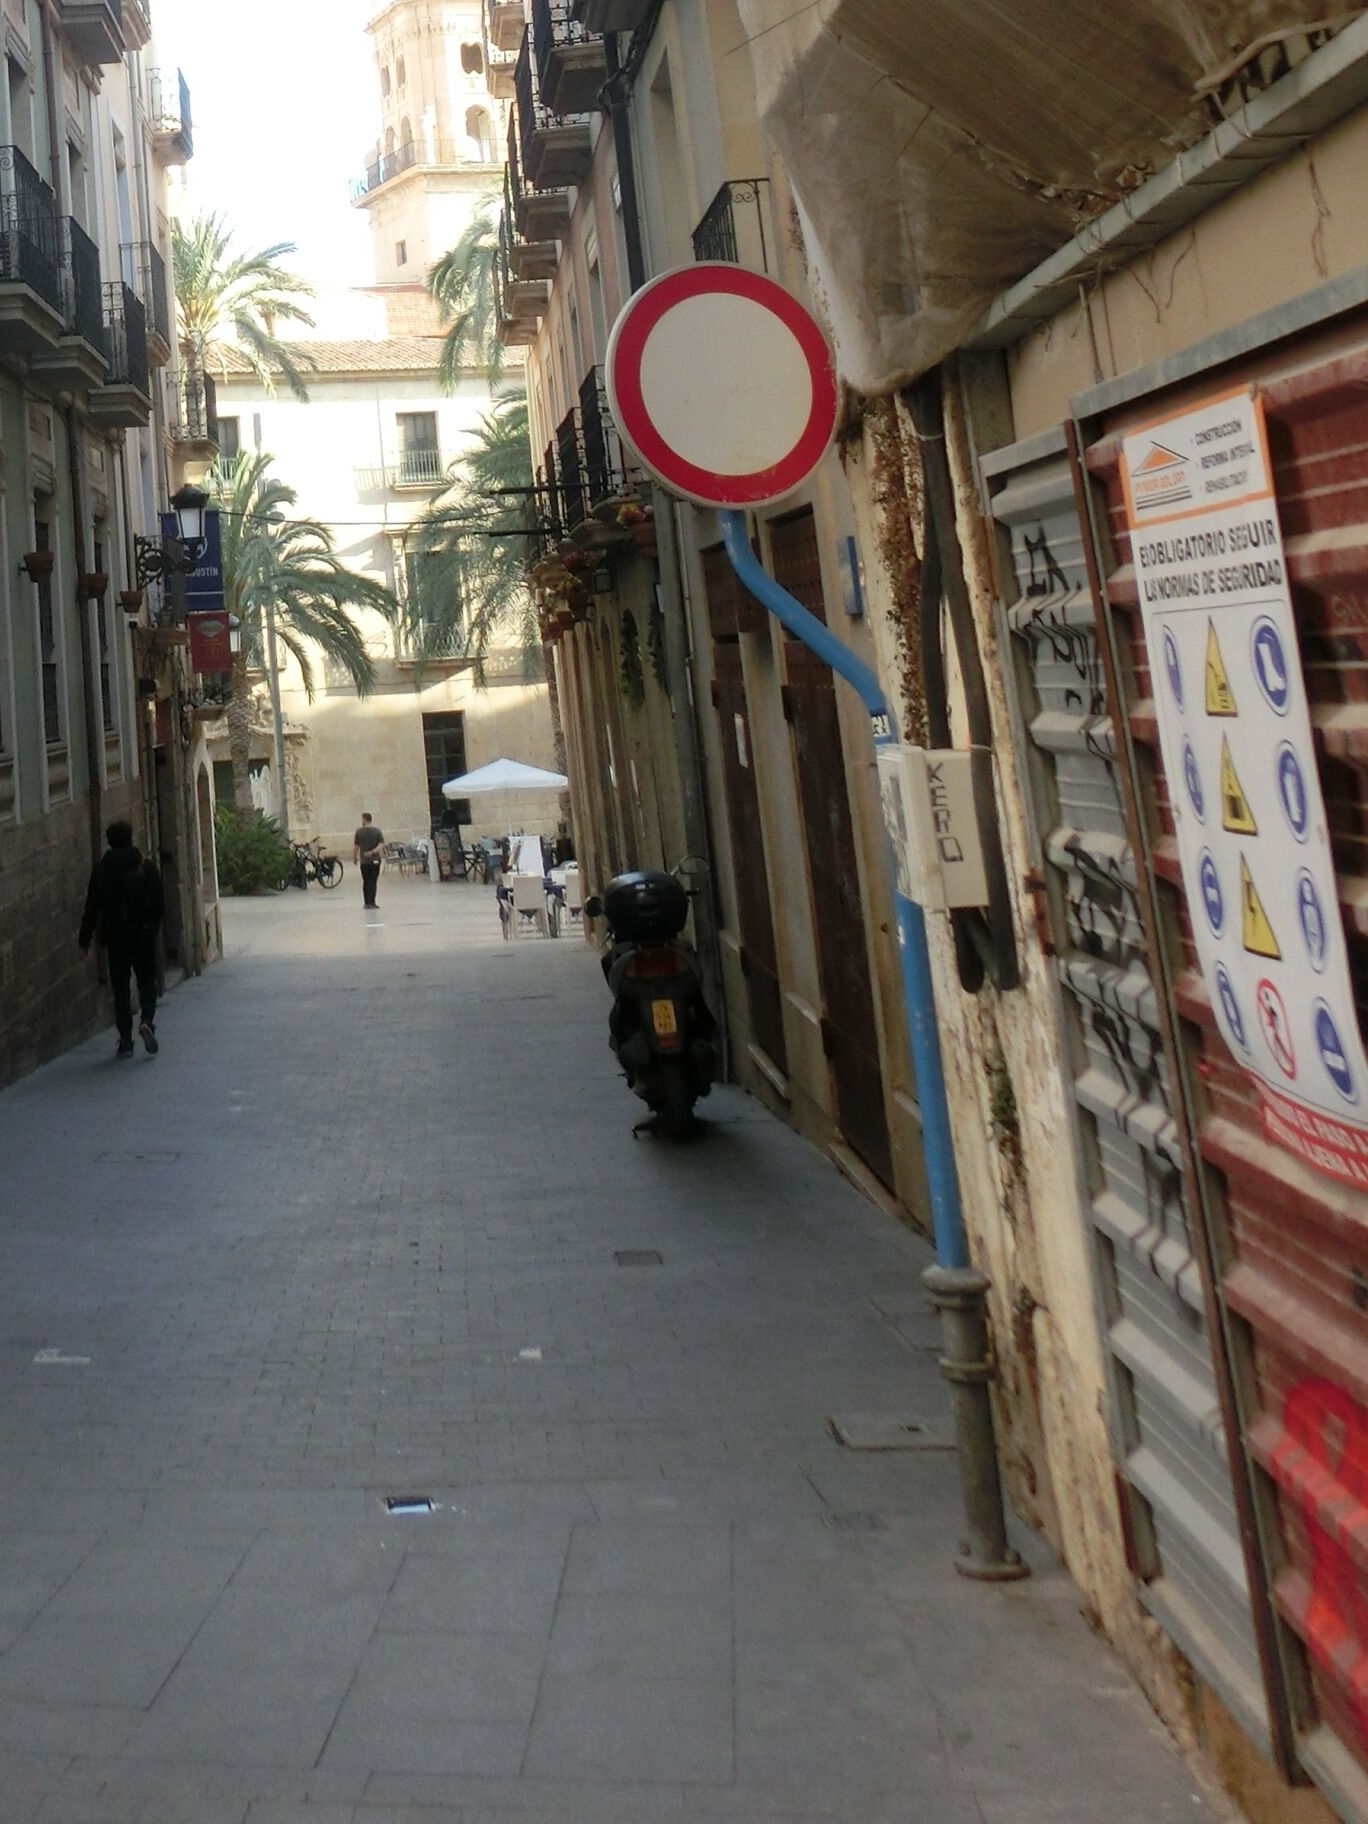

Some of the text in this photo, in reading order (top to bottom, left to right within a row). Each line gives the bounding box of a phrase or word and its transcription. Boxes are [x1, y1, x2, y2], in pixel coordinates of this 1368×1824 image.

[1149, 529, 1226, 566] OBLIGATORIO
[1229, 519, 1277, 553] SEGUIR
[1157, 572, 1200, 600] NORMAS
[1202, 569, 1216, 595] DE
[1218, 559, 1282, 594] SEGURIDAD
